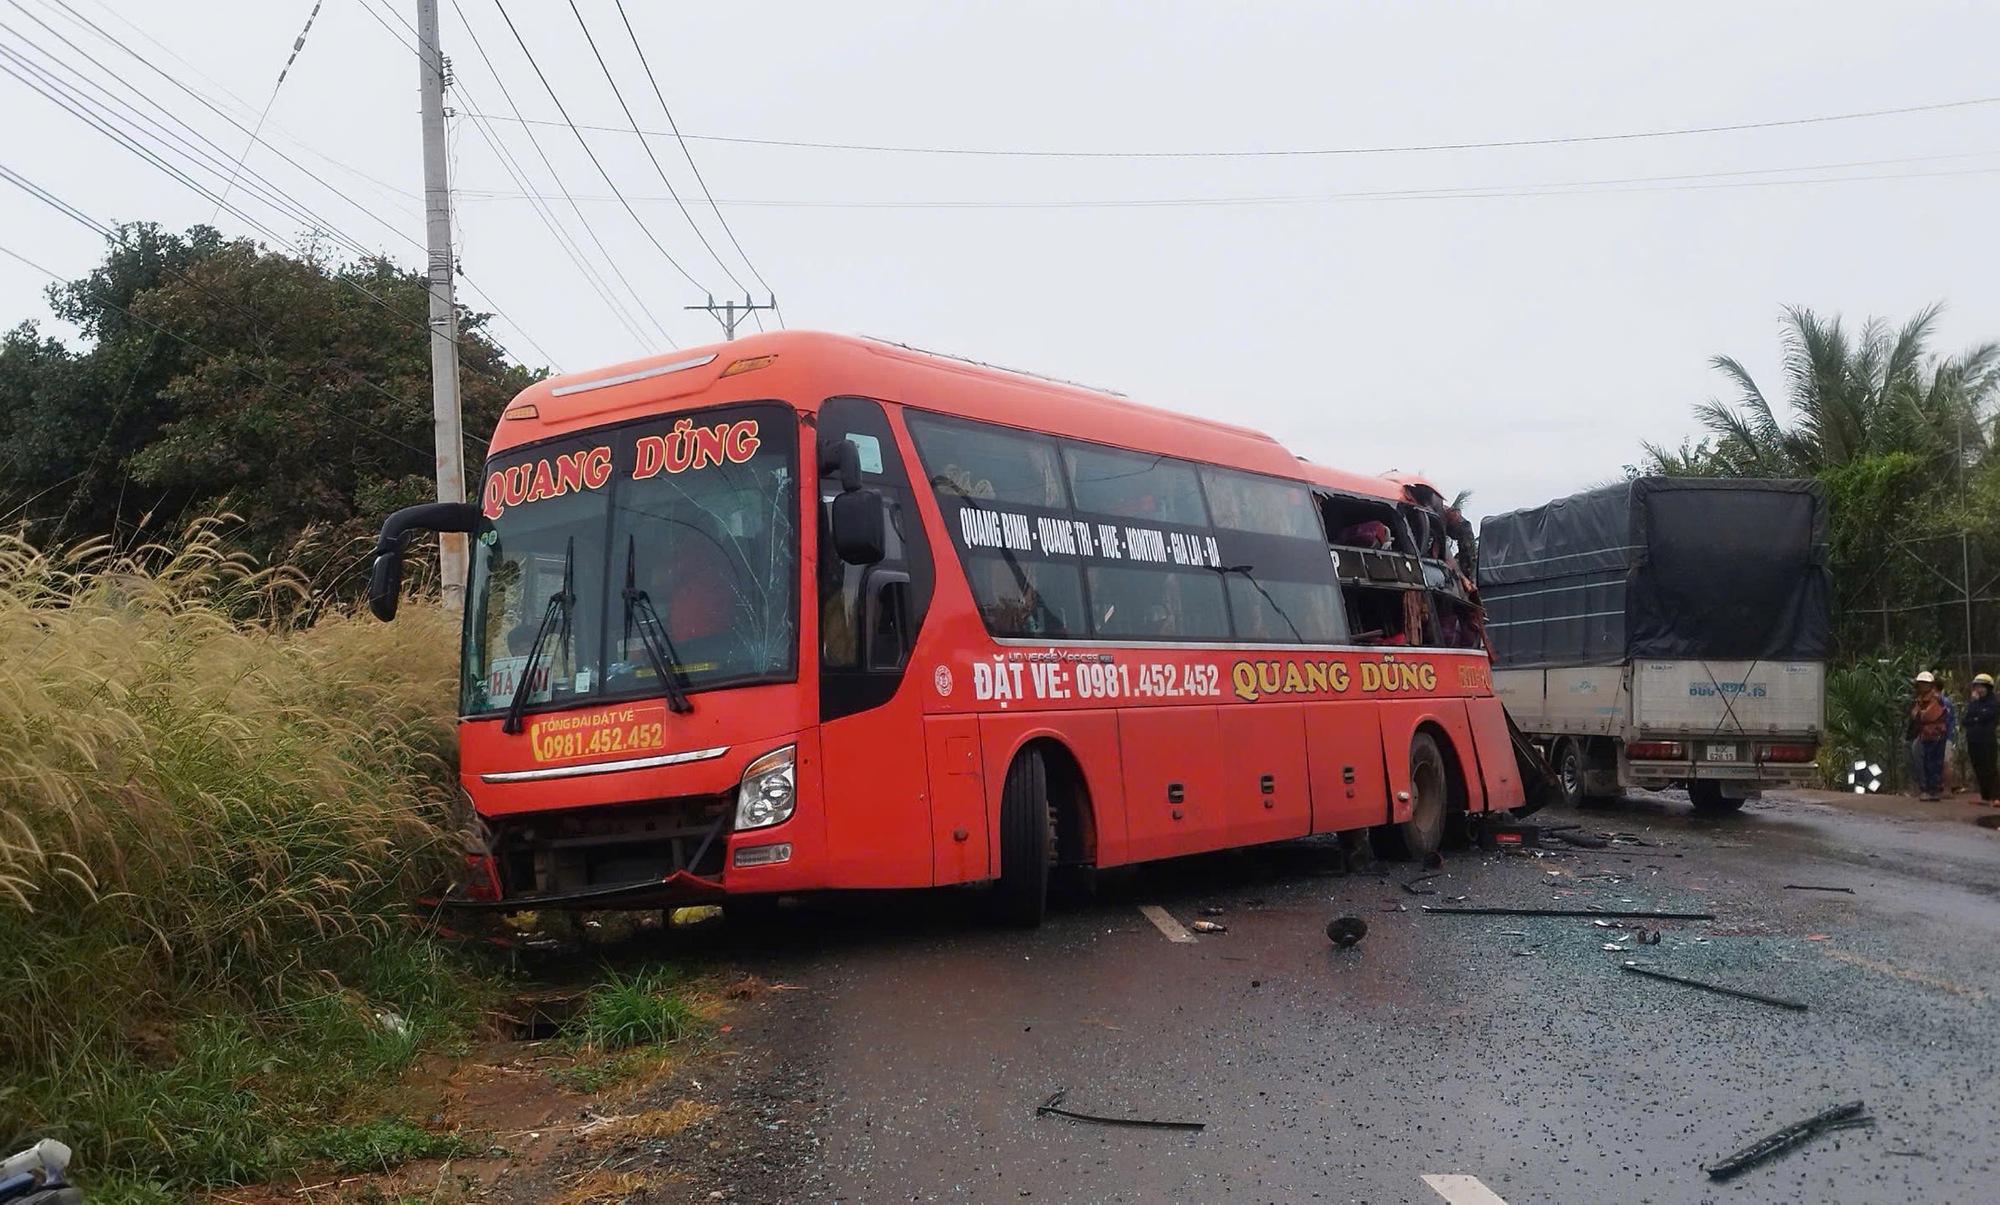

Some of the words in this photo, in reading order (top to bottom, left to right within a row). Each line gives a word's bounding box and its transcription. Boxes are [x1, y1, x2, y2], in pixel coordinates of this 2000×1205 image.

[484, 446, 613, 520] QUANG
[632, 418, 761, 480] DŨNG
[959, 507, 1003, 549] QUANG
[1037, 517, 1076, 556] QUANG
[1125, 526, 1167, 562] KONTUM
[1170, 532, 1190, 565] GIA
[1186, 534, 1205, 566] LAI
[974, 654, 1024, 708] ĐẶT
[1076, 663, 1220, 698] 0981.452.452
[1231, 660, 1350, 702] QUANG
[1359, 653, 1438, 693] DŨNG
[543, 723, 662, 760] 0981.452.452
